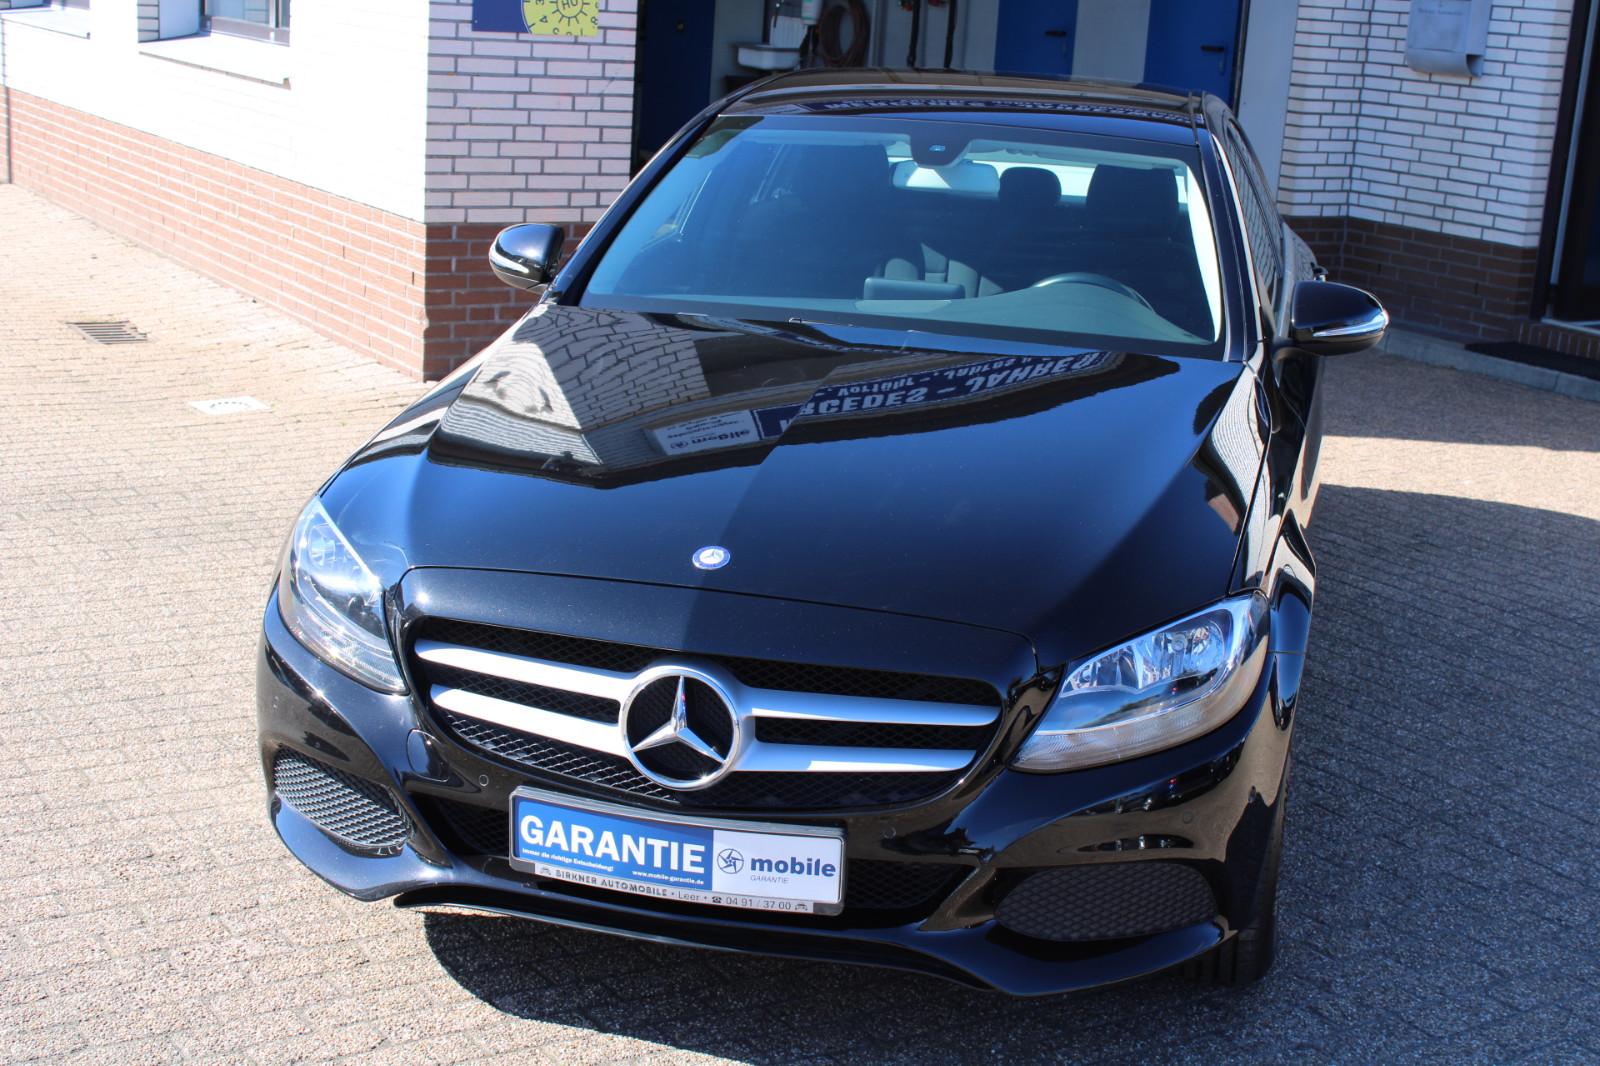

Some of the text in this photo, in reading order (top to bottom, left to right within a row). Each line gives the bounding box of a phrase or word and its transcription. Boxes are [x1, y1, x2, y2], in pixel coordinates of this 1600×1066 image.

[520, 815, 705, 874] GARANTIE
[750, 857, 836, 877] mobile
[750, 875, 790, 884] GARANTIE
[600, 879, 667, 896] AUTOMOBILE
[678, 890, 700, 901] Leer
[741, 898, 753, 907] 91
[763, 900, 776, 909] 37
